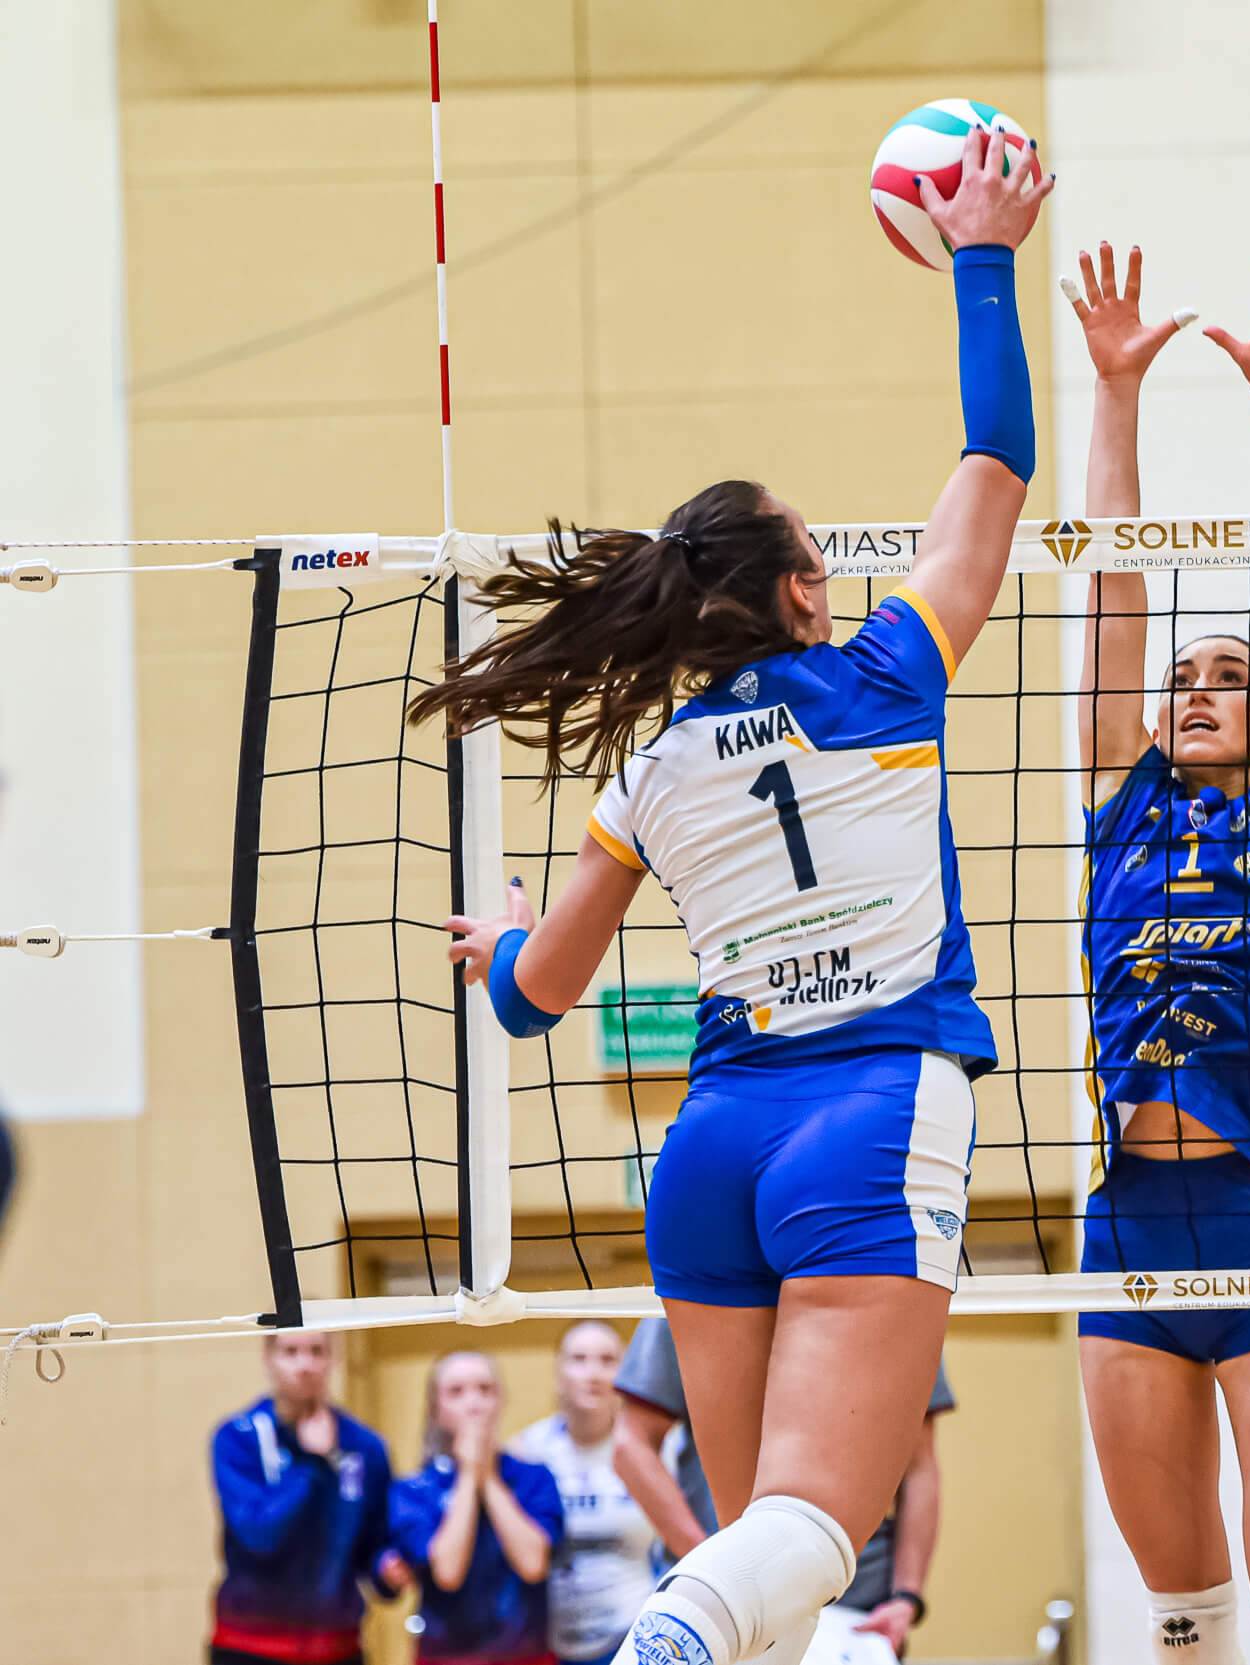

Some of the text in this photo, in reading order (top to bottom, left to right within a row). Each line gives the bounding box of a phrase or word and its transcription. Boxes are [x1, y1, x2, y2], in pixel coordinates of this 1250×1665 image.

[808, 529, 924, 558] MIAST
[292, 549, 370, 571] netex
[831, 564, 910, 576] REKREACYJN
[1114, 558, 1173, 568] CENTRUM
[715, 706, 795, 760] KAWA
[748, 760, 818, 892] 1
[1178, 832, 1202, 878] 1
[799, 915, 826, 927] Bank
